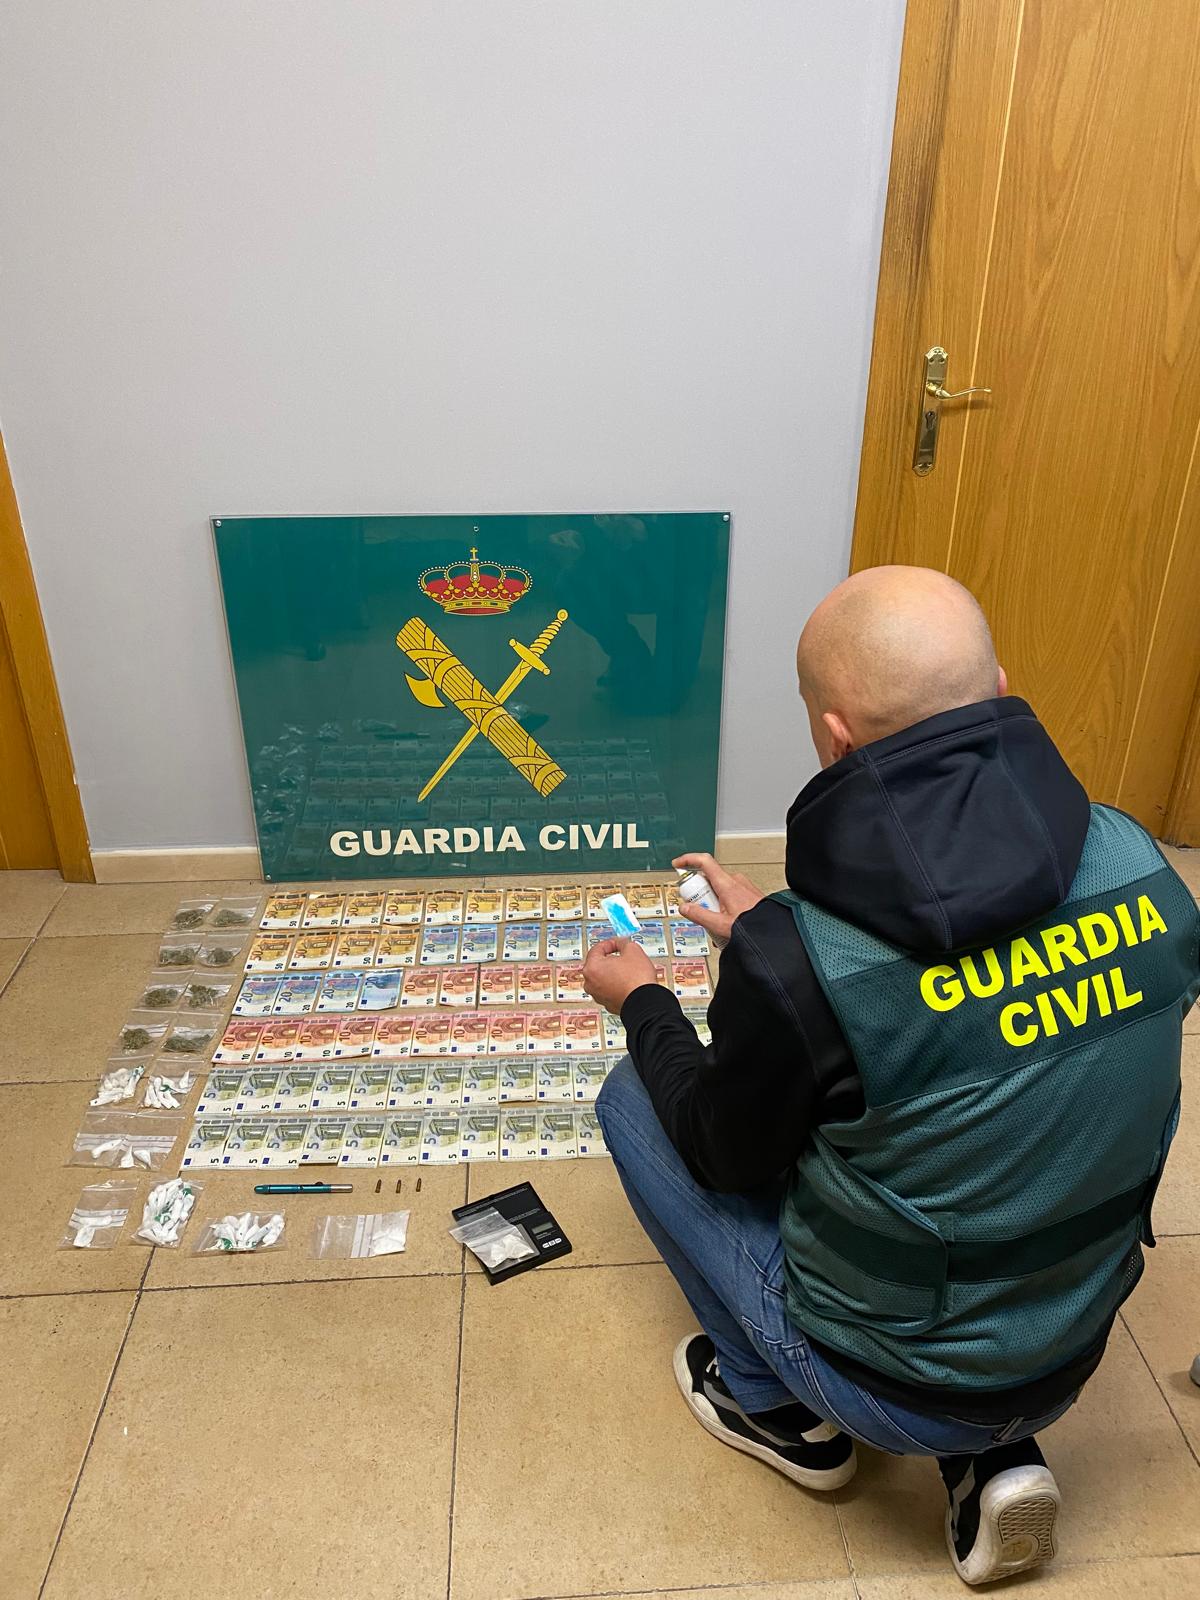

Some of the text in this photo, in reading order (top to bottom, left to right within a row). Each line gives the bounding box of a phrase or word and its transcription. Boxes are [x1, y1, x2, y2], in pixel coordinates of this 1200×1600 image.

[329, 822, 650, 858] GUARDIA CIVIL
[428, 904, 438, 913] 50
[468, 903, 478, 912] 50
[508, 902, 519, 912] 50
[550, 902, 560, 910] 50
[590, 900, 600, 909] 50
[347, 908, 358, 916] 50
[387, 905, 398, 916] 50
[506, 940, 517, 950] 20
[548, 938, 560, 948] 20
[676, 936, 686, 946] 20
[380, 947, 392, 956] 50
[424, 944, 435, 952] 20
[463, 942, 474, 952] 20
[250, 951, 262, 960] 50
[295, 950, 307, 958] 50
[337, 948, 350, 956] 50
[919, 895, 1168, 1012] GUARDIA
[482, 982, 492, 990] 10
[520, 980, 531, 988] 10
[558, 980, 568, 988] 10
[404, 984, 416, 994] 10
[240, 993, 254, 1004] 20
[280, 992, 293, 1002] 20
[320, 989, 335, 999] 20
[1000, 967, 1143, 1047] CIVIL
[378, 1031, 390, 1040] 10
[416, 1030, 428, 1040] 10
[454, 1030, 466, 1040] 10
[492, 1030, 503, 1039] 10
[529, 1029, 540, 1037] 10
[566, 1027, 577, 1036] 10
[222, 1037, 235, 1046] 10
[262, 1036, 274, 1046] 10
[300, 1035, 312, 1044] 10
[339, 1032, 351, 1042] 10
